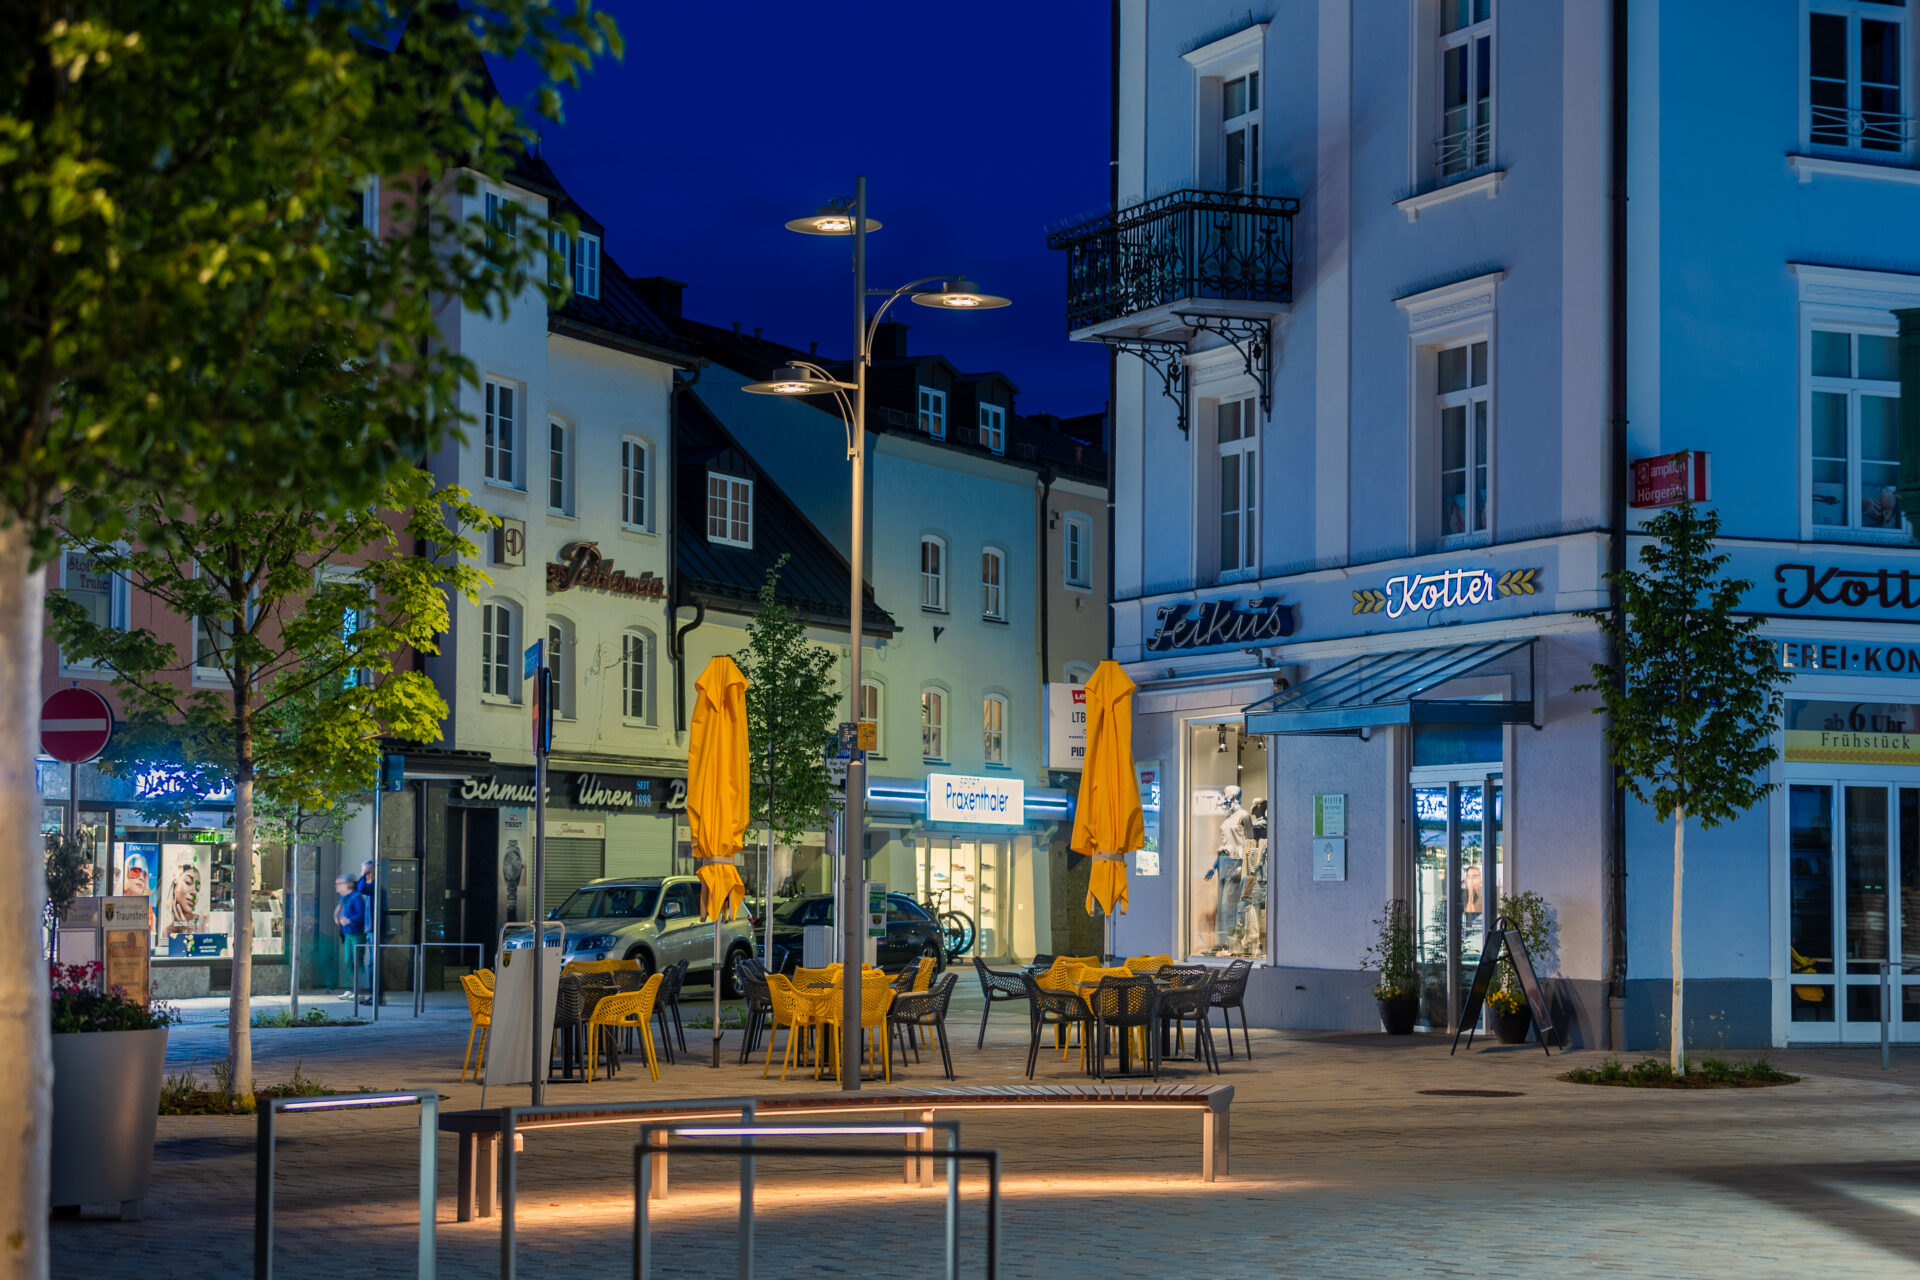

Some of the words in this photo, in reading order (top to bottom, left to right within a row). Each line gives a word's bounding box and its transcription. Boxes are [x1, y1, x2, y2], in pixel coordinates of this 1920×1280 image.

[1386, 568, 1494, 618] Kotter
[1849, 703, 1866, 731] 6
[1871, 714, 1906, 733] Uhr
[1821, 732, 1911, 749] Frühstück
[1071, 746, 1086, 757] PIO
[577, 773, 634, 807] Uhren
[636, 780, 651, 790] SEIT
[634, 794, 651, 808] 1898
[946, 782, 1009, 812] Praxenthaler
[116, 911, 147, 921] Traunstein
